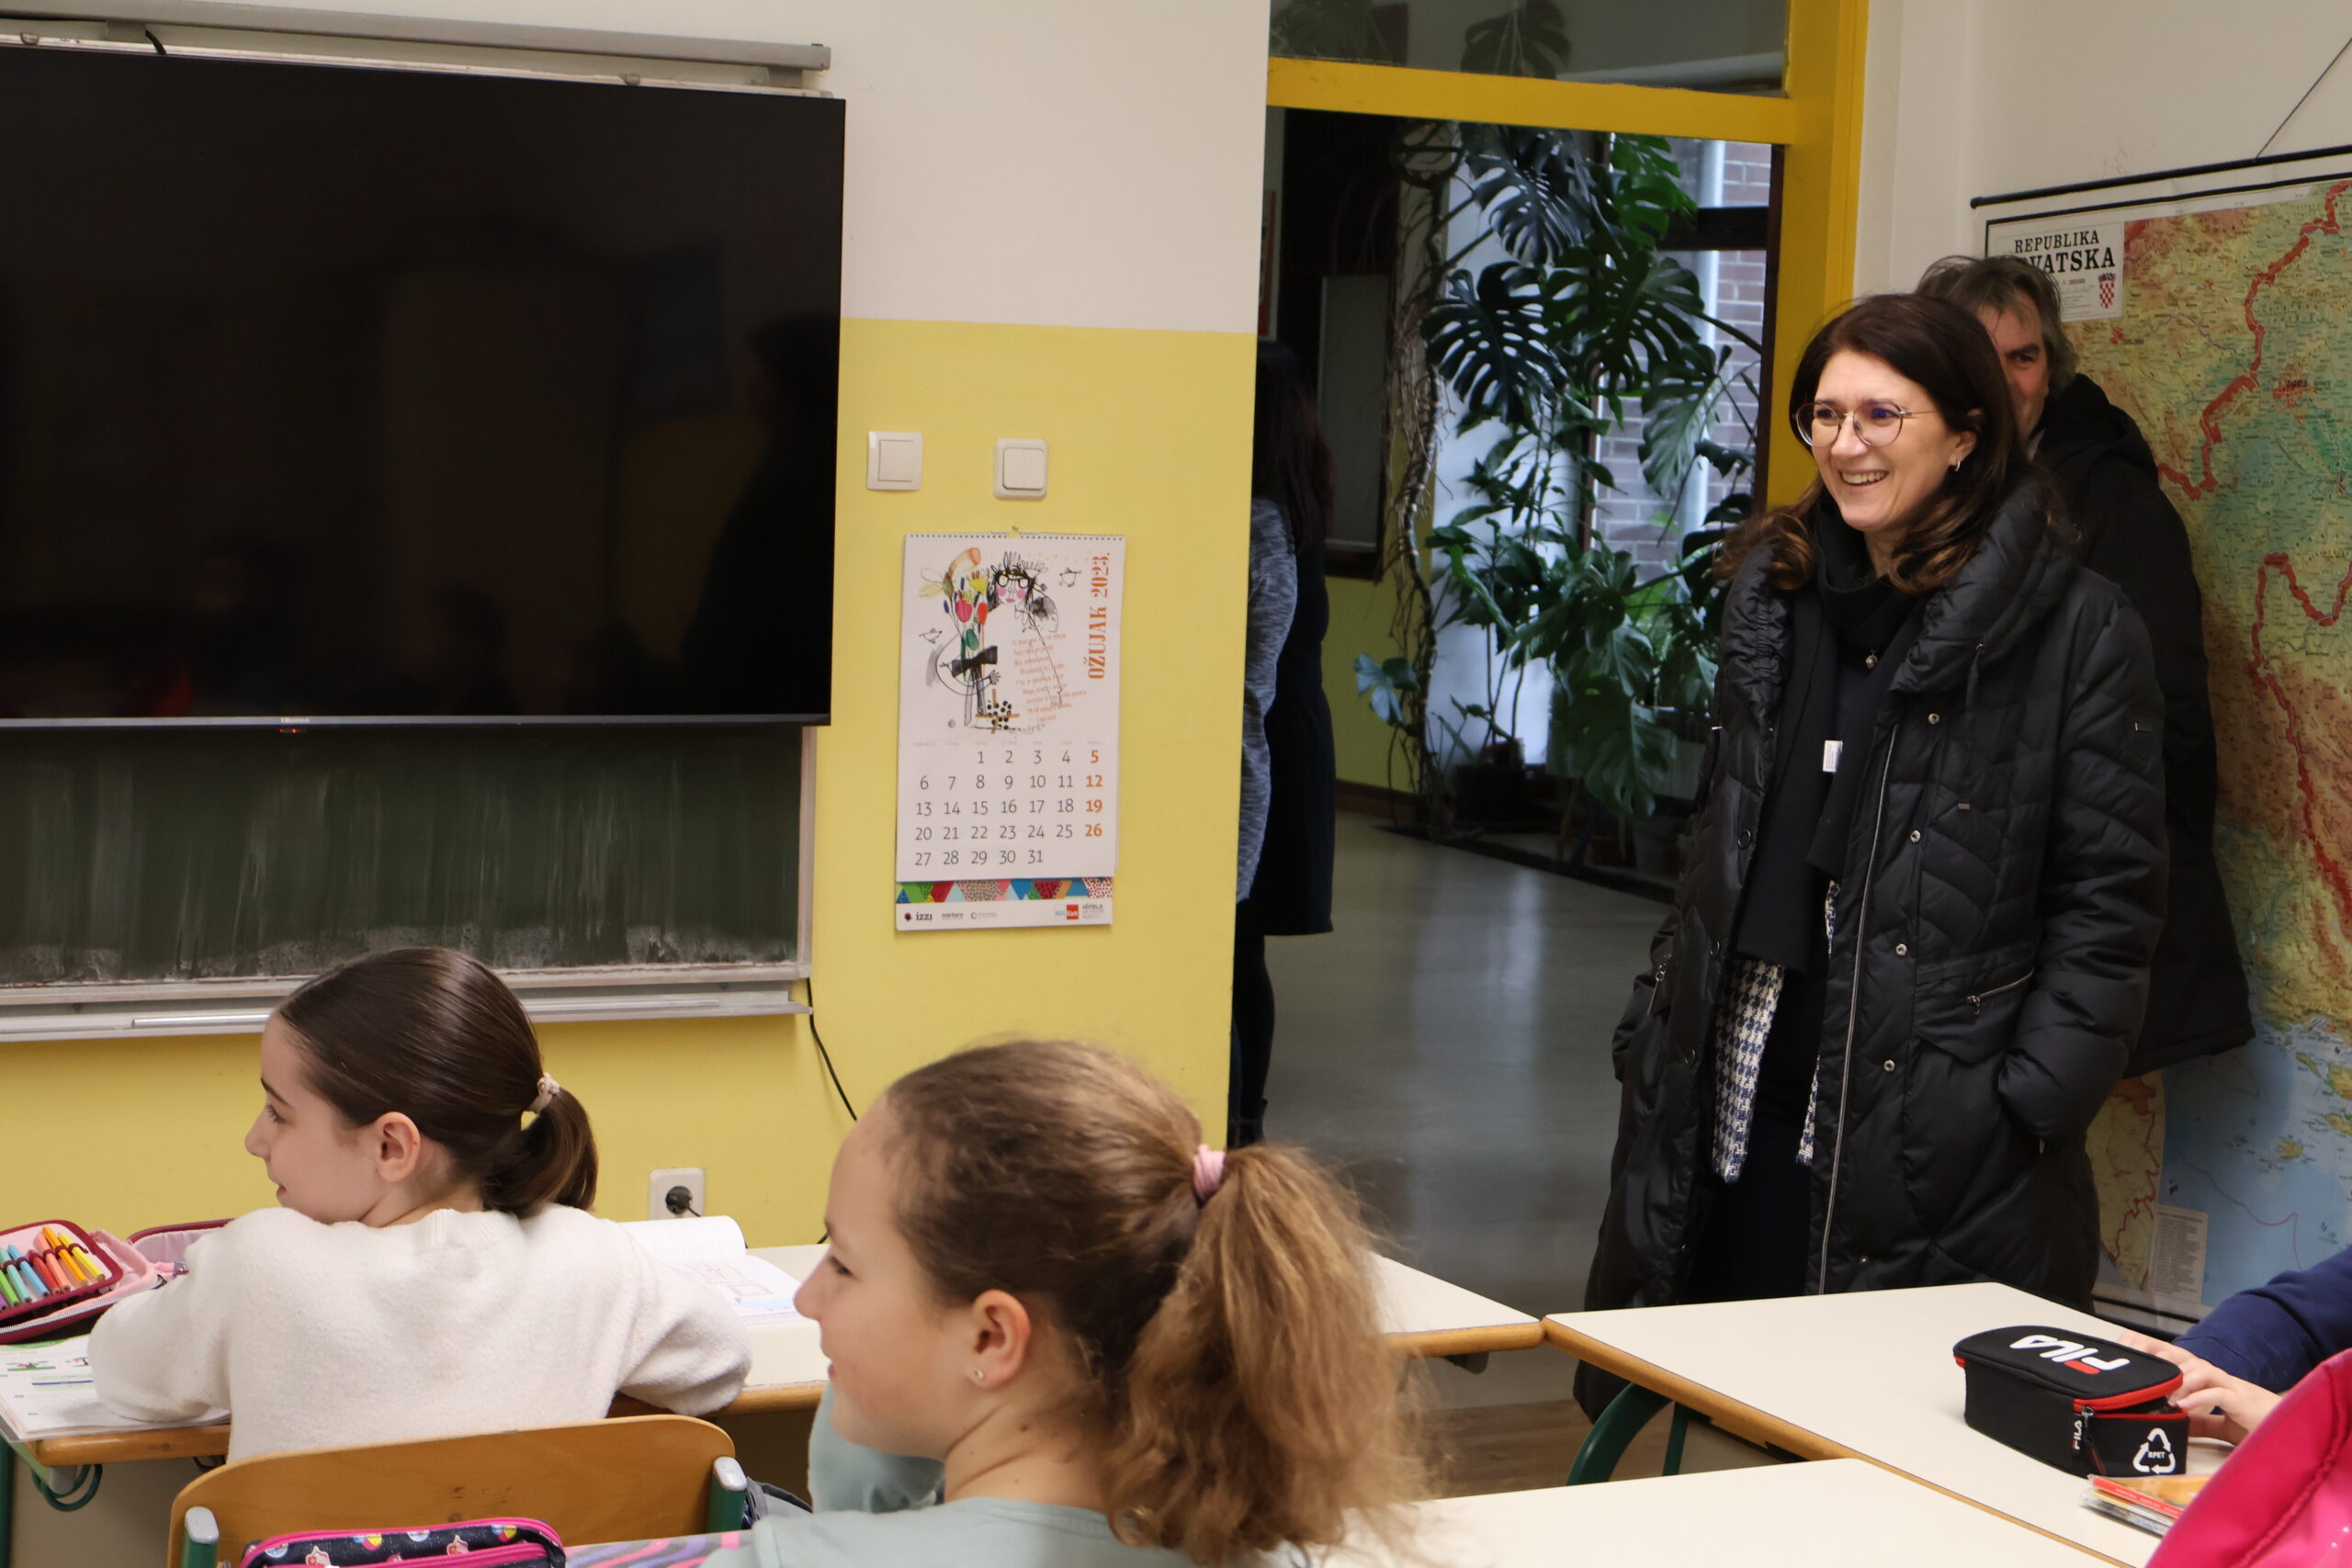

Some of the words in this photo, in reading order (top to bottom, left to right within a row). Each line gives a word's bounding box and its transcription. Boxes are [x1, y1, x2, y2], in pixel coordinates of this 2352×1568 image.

[2015, 230, 2099, 254] REPUBLIKA
[2029, 246, 2115, 274] VATSKA
[1083, 605, 1107, 680] OŽUJAK
[978, 751, 984, 764] 1
[1005, 750, 1012, 763] 2
[1034, 750, 1041, 764] 3
[1062, 750, 1070, 763] 4
[1091, 750, 1099, 764] 5
[921, 775, 929, 790] 6
[948, 776, 956, 790] 7
[977, 774, 985, 789] 8
[1004, 775, 1012, 789] 9
[1030, 775, 1046, 788] 10
[1058, 775, 1073, 788] 11
[1087, 774, 1102, 787] 12
[917, 802, 932, 816] 13
[944, 801, 961, 815] 14
[973, 801, 988, 815] 15
[1001, 799, 1017, 813] 16
[1030, 800, 1045, 813] 17
[1058, 798, 1073, 813] 18
[1087, 800, 1102, 813] 19
[916, 827, 932, 840] 20
[944, 827, 959, 840] 21
[971, 826, 987, 839] 22
[1000, 826, 1016, 840] 23
[1028, 825, 1045, 838] 24
[1057, 825, 1072, 839] 25
[1086, 823, 1102, 837] 26
[915, 852, 931, 866] 27
[944, 851, 959, 865] 28
[971, 852, 987, 865] 29
[1000, 851, 1015, 864] 30
[1028, 850, 1043, 864] 31
[2009, 1335, 2131, 1375] FILA
[2073, 1420, 2082, 1450] FILA
